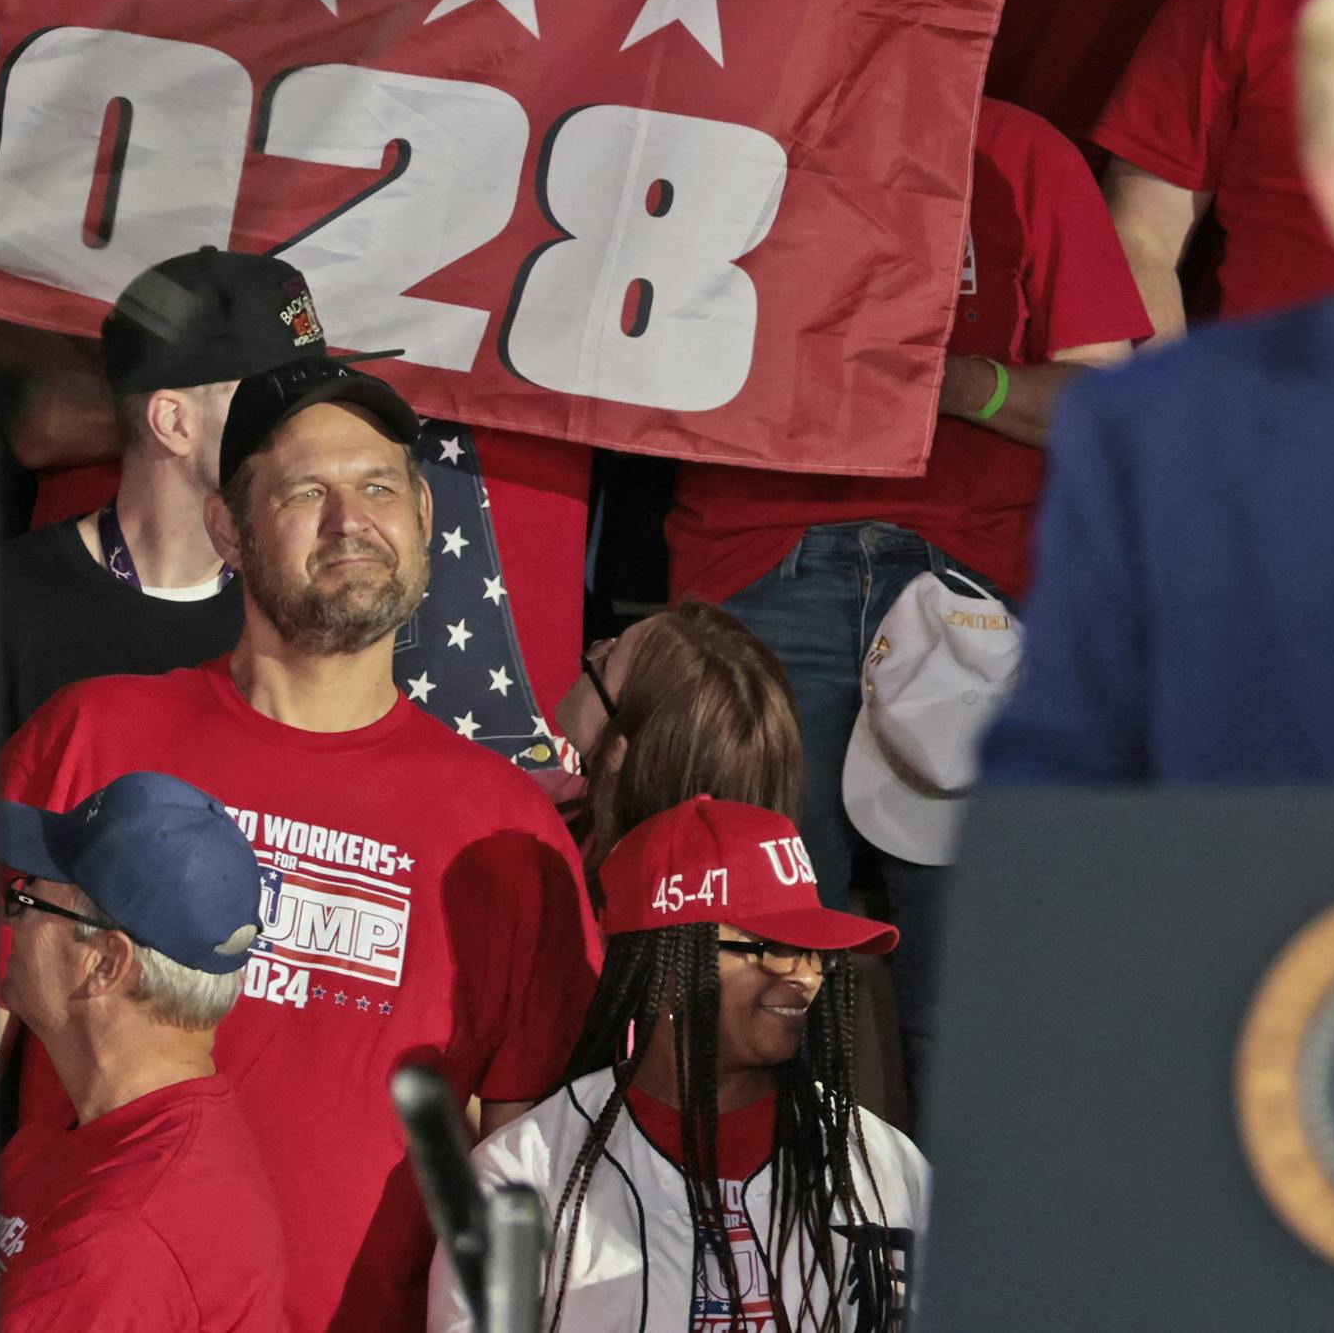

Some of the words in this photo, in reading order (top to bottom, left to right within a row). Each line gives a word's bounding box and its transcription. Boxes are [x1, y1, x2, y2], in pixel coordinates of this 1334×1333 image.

[264, 814, 398, 876] WORKERS
[273, 852, 298, 871] FOR
[758, 836, 818, 886] US
[652, 868, 728, 915] 45-47
[258, 888, 401, 962] UMP
[241, 957, 311, 1009] 024
